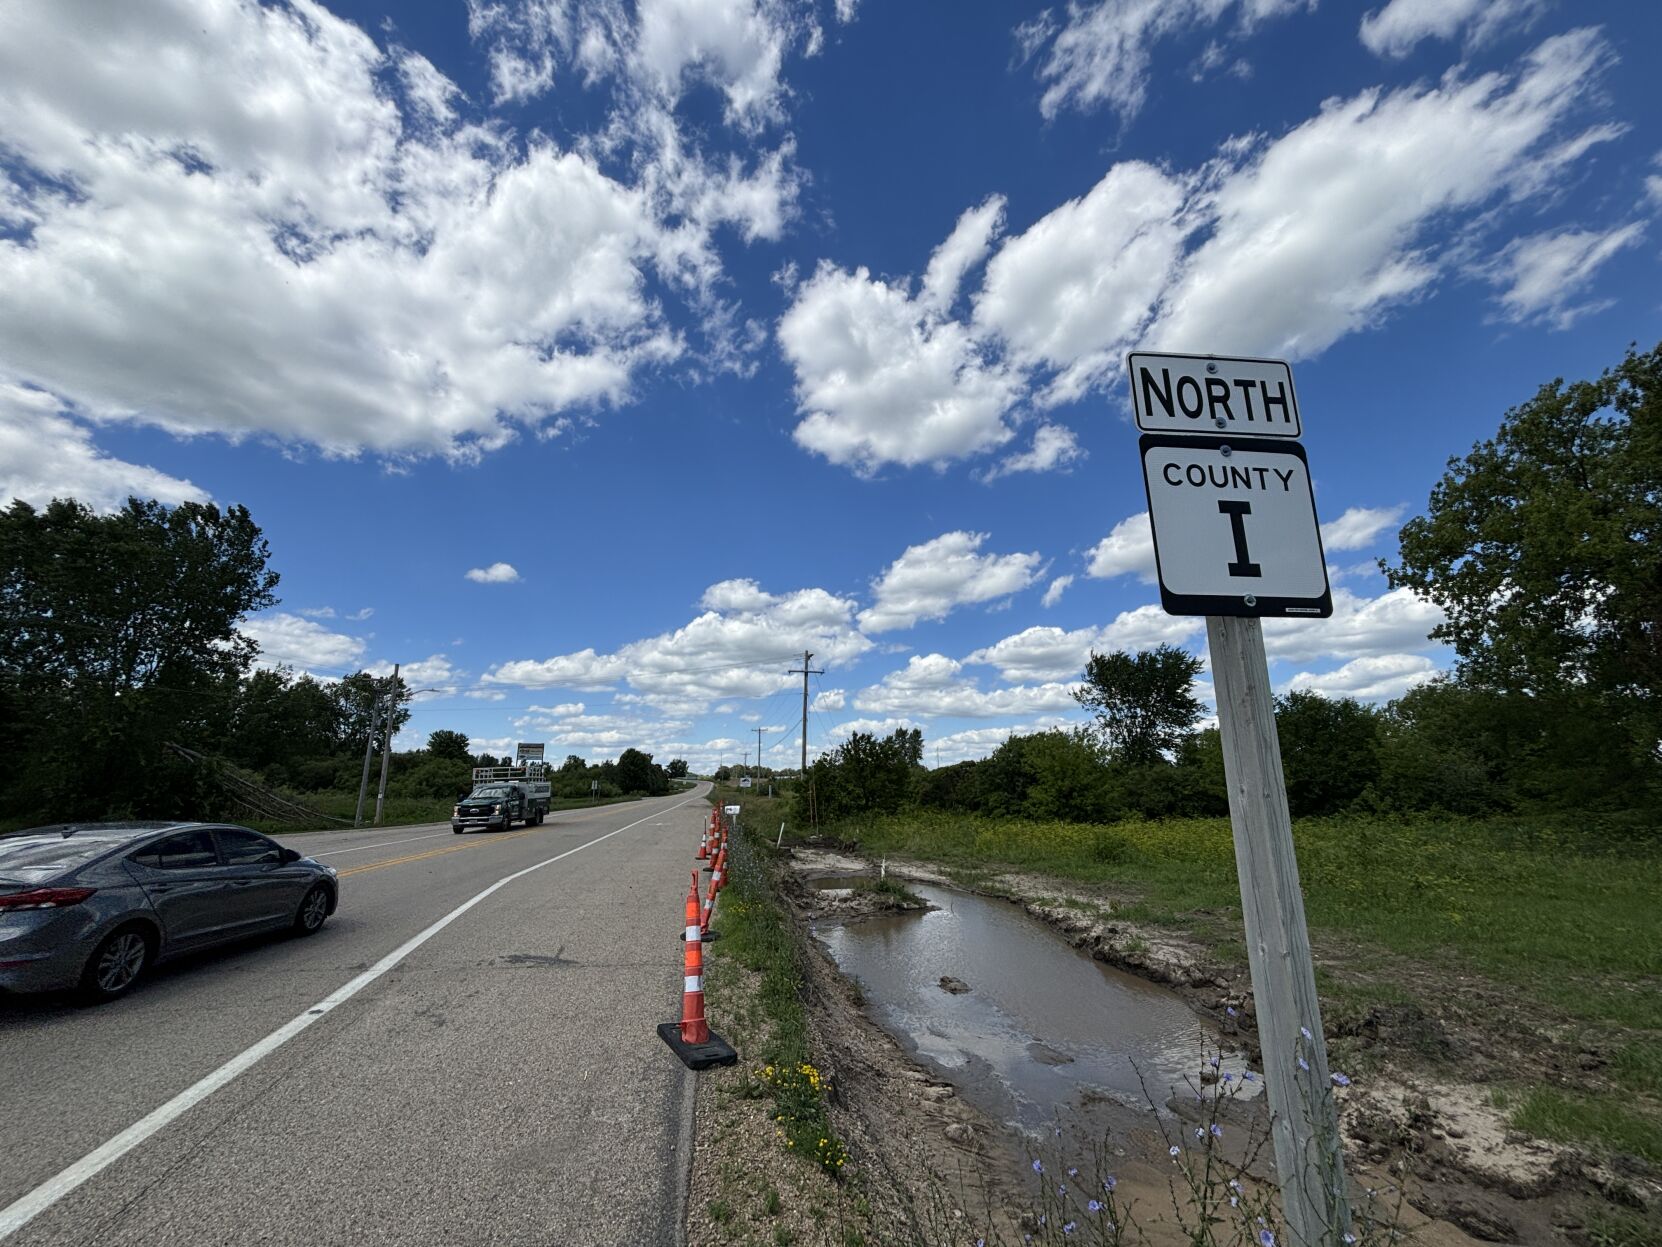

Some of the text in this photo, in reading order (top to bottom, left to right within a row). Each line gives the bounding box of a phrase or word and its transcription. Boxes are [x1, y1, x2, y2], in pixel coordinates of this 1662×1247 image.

[1140, 367, 1290, 423] NORTH
[1163, 463, 1293, 491] COUNTY
[1218, 500, 1262, 577] I
